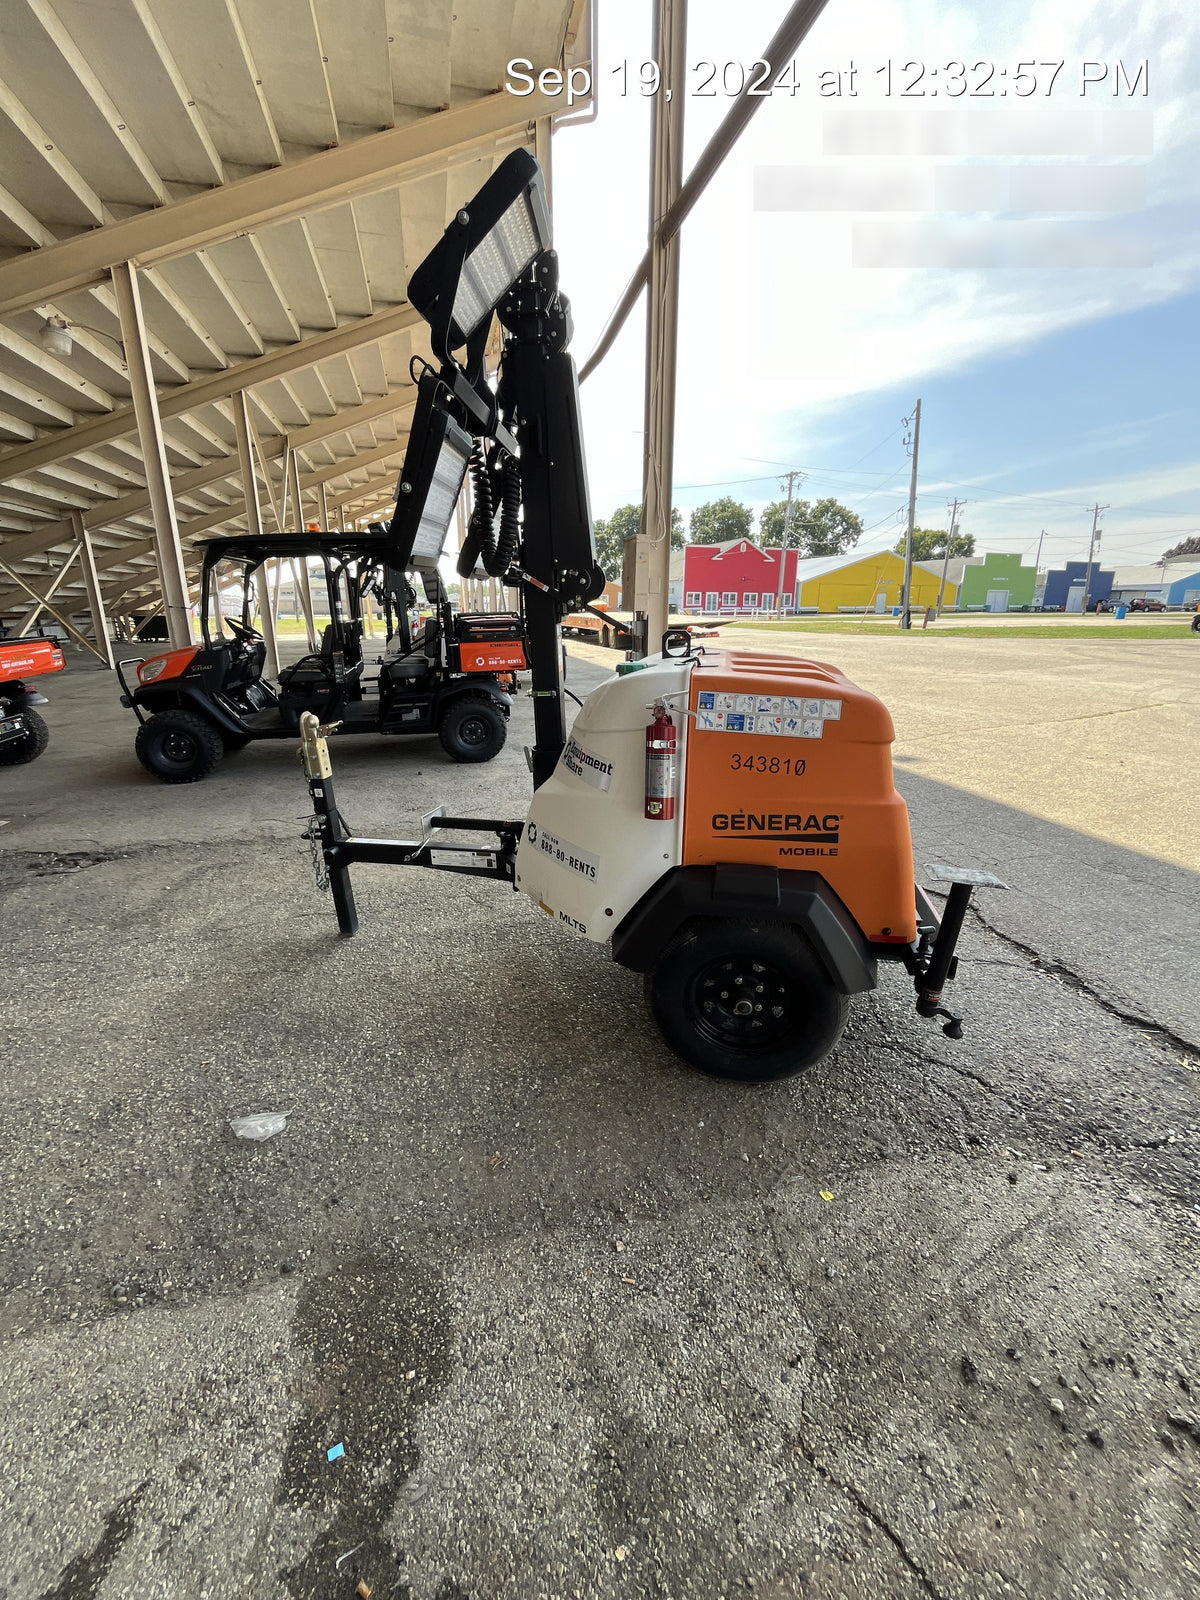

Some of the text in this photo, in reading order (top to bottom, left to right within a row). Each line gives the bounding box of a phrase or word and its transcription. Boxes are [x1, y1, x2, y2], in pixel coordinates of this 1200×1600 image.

[730, 753, 806, 776] 343810
[711, 813, 840, 831] GENERAC
[540, 839, 597, 878] 888-80-RENTS
[779, 847, 839, 857] MOBILE
[559, 910, 587, 934] MLTS
